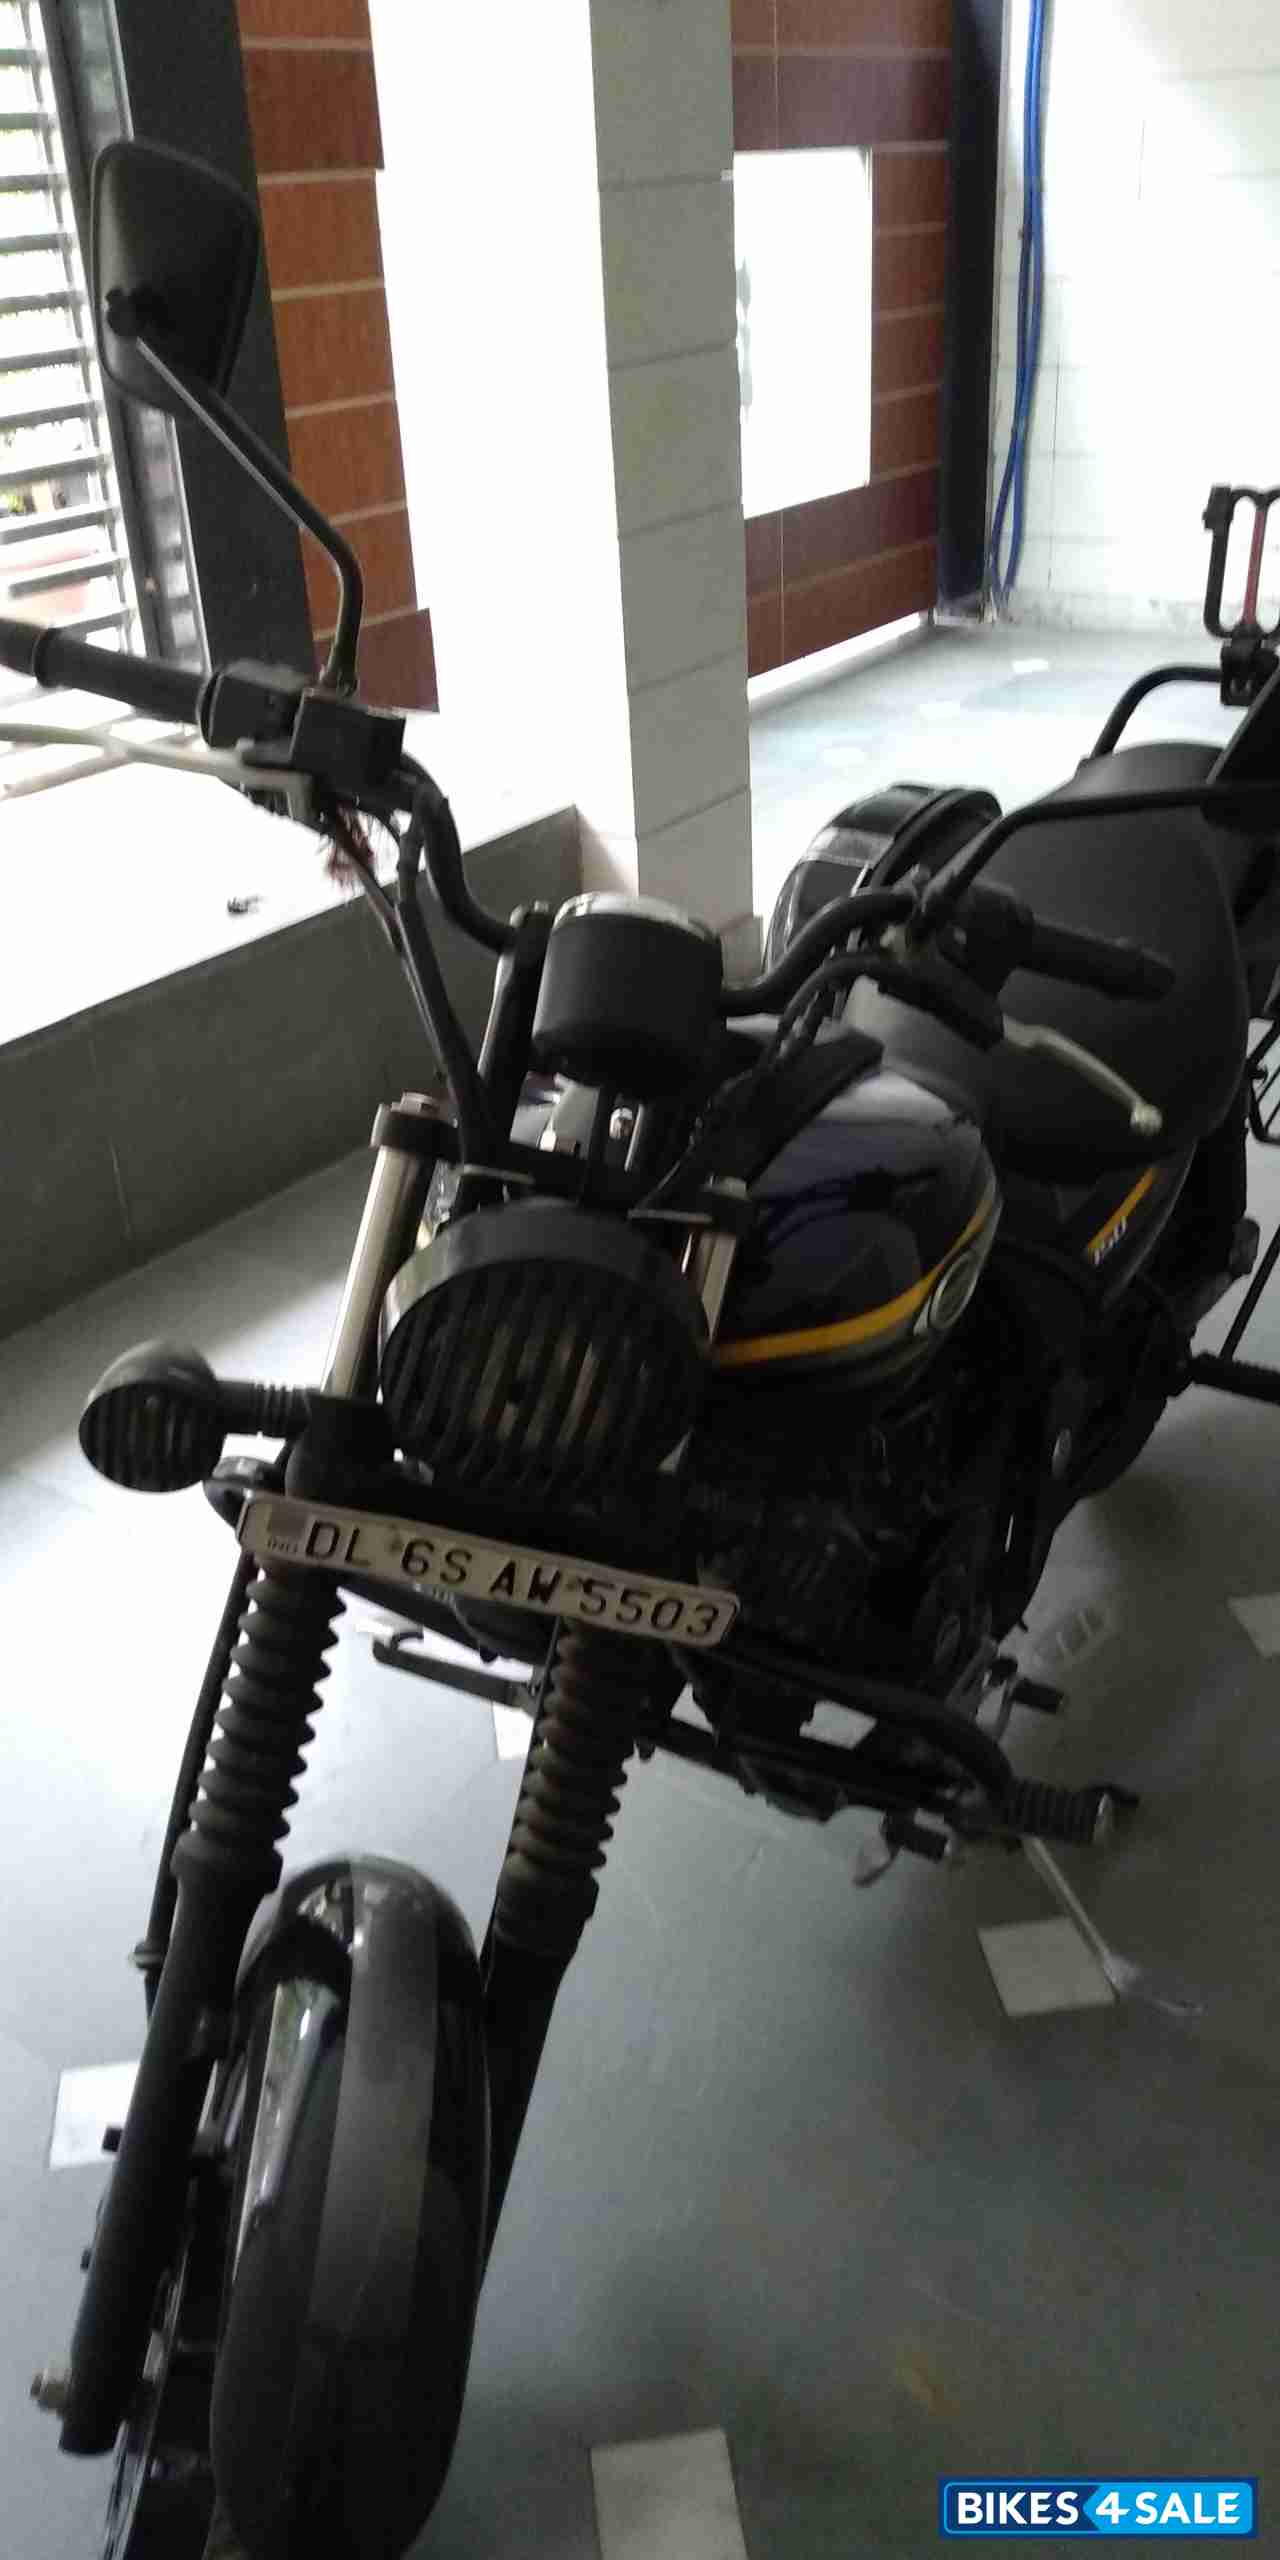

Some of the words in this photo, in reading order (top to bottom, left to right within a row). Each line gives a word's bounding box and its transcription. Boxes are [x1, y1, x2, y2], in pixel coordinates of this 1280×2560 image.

[305, 1520, 371, 1567] DL
[401, 1538, 473, 1584] 6S
[489, 1560, 561, 1604] AW
[578, 1576, 720, 1637] 5503
